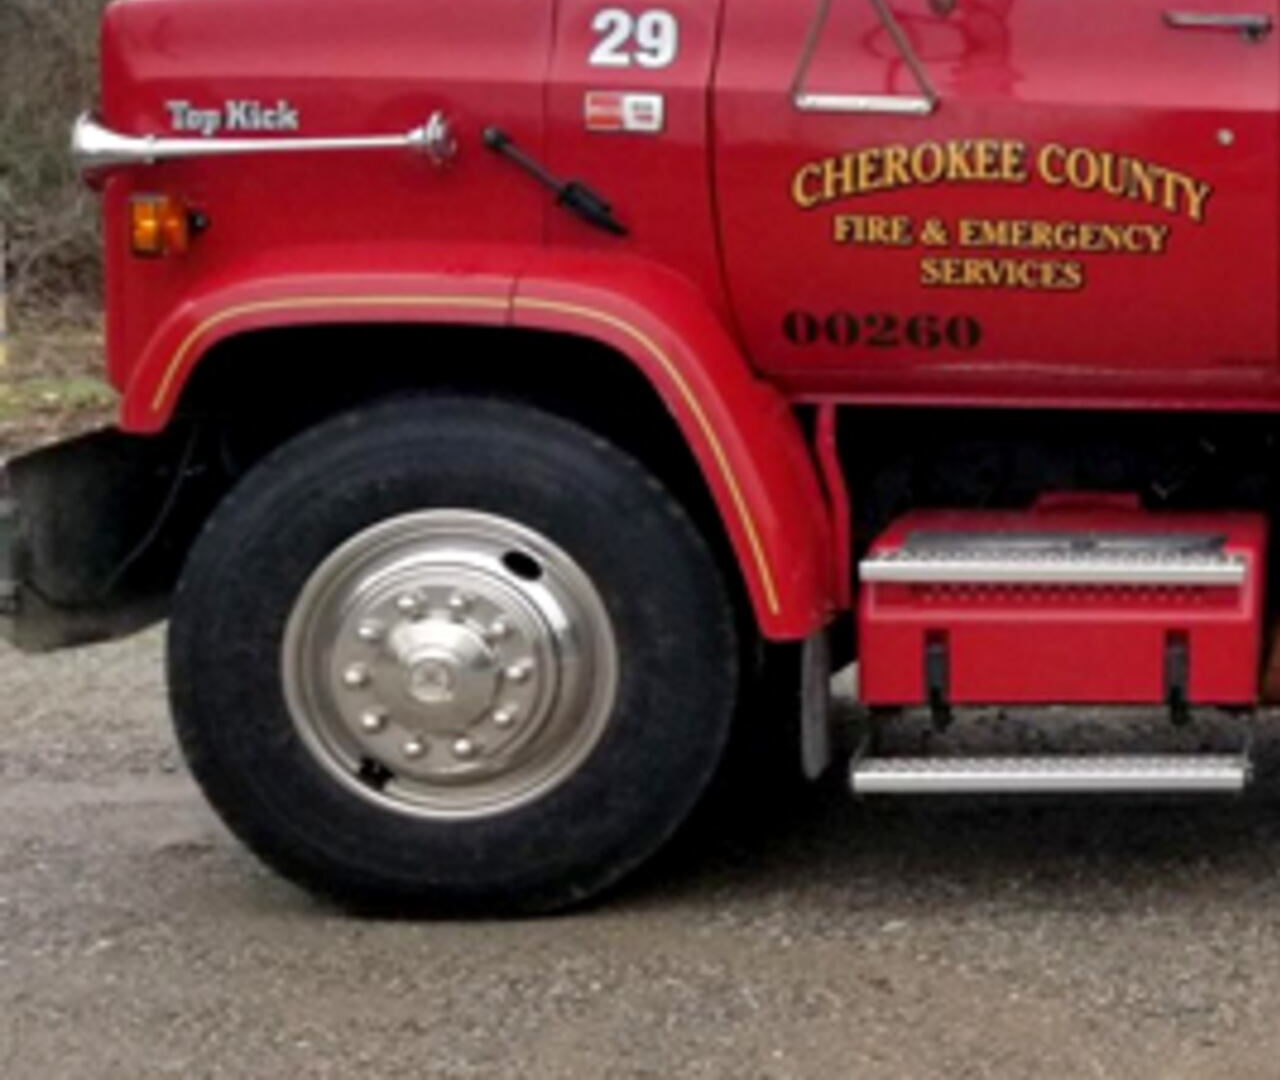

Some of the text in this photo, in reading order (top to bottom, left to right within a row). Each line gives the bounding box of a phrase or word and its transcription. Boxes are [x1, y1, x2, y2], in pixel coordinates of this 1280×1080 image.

[589, 7, 679, 69] 29
[165, 98, 299, 136] Top Kick
[791, 139, 1211, 221] CHEROKEE COUNTY
[833, 215, 1168, 253] FIRE & EMERGENCY
[920, 257, 1083, 289] SERVICES
[782, 311, 983, 350] 00260
